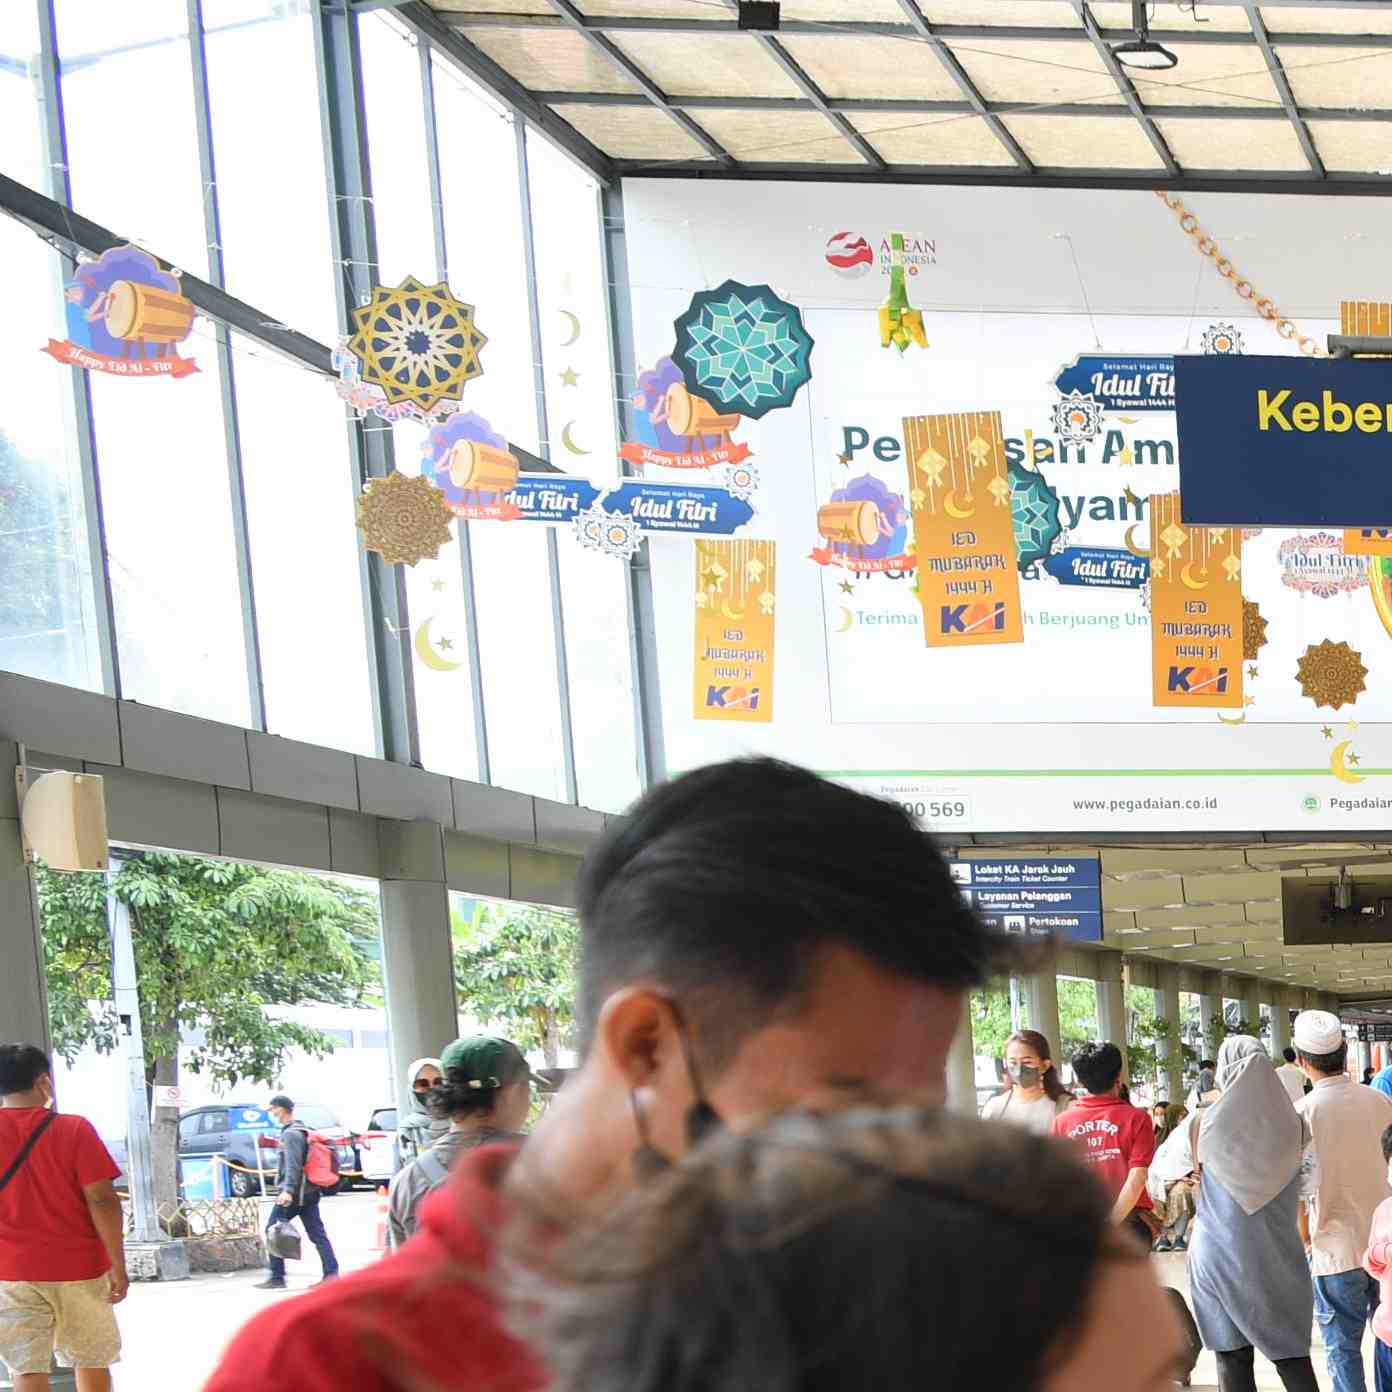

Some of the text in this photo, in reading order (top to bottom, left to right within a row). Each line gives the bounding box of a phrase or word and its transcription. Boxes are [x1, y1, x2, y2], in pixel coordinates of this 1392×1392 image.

[880, 238, 936, 253] AEAN
[880, 255, 937, 265] INONESIA
[1159, 363, 1175, 371] Ray
[1090, 371, 1176, 397] Idul Fit
[1101, 429, 1176, 466] Am
[537, 490, 580, 512] Fitri
[630, 496, 719, 521] Idul Fitri
[951, 531, 977, 546] IED
[928, 553, 1008, 572] MUBARAK
[1071, 558, 1146, 579] Idul Fitri
[945, 579, 993, 594] 1444 H
[1183, 600, 1208, 614] IED
[856, 610, 919, 625] Terima
[940, 601, 1006, 634] KAI
[1039, 611, 1121, 630] Berjuang
[1124, 611, 1148, 626] Un
[1161, 622, 1233, 639] MUBARAK
[1175, 645, 1219, 660] 1444 H
[1167, 665, 1229, 693] KAI
[705, 685, 760, 710] KAI
[930, 801, 965, 817] 569
[1072, 796, 1218, 812] www.pegadaian.co.id
[974, 864, 1076, 874] Loket KA Jarak Jauh
[977, 891, 1072, 902] Layanan Pelanggan
[1028, 916, 1079, 927] Pertokoan
